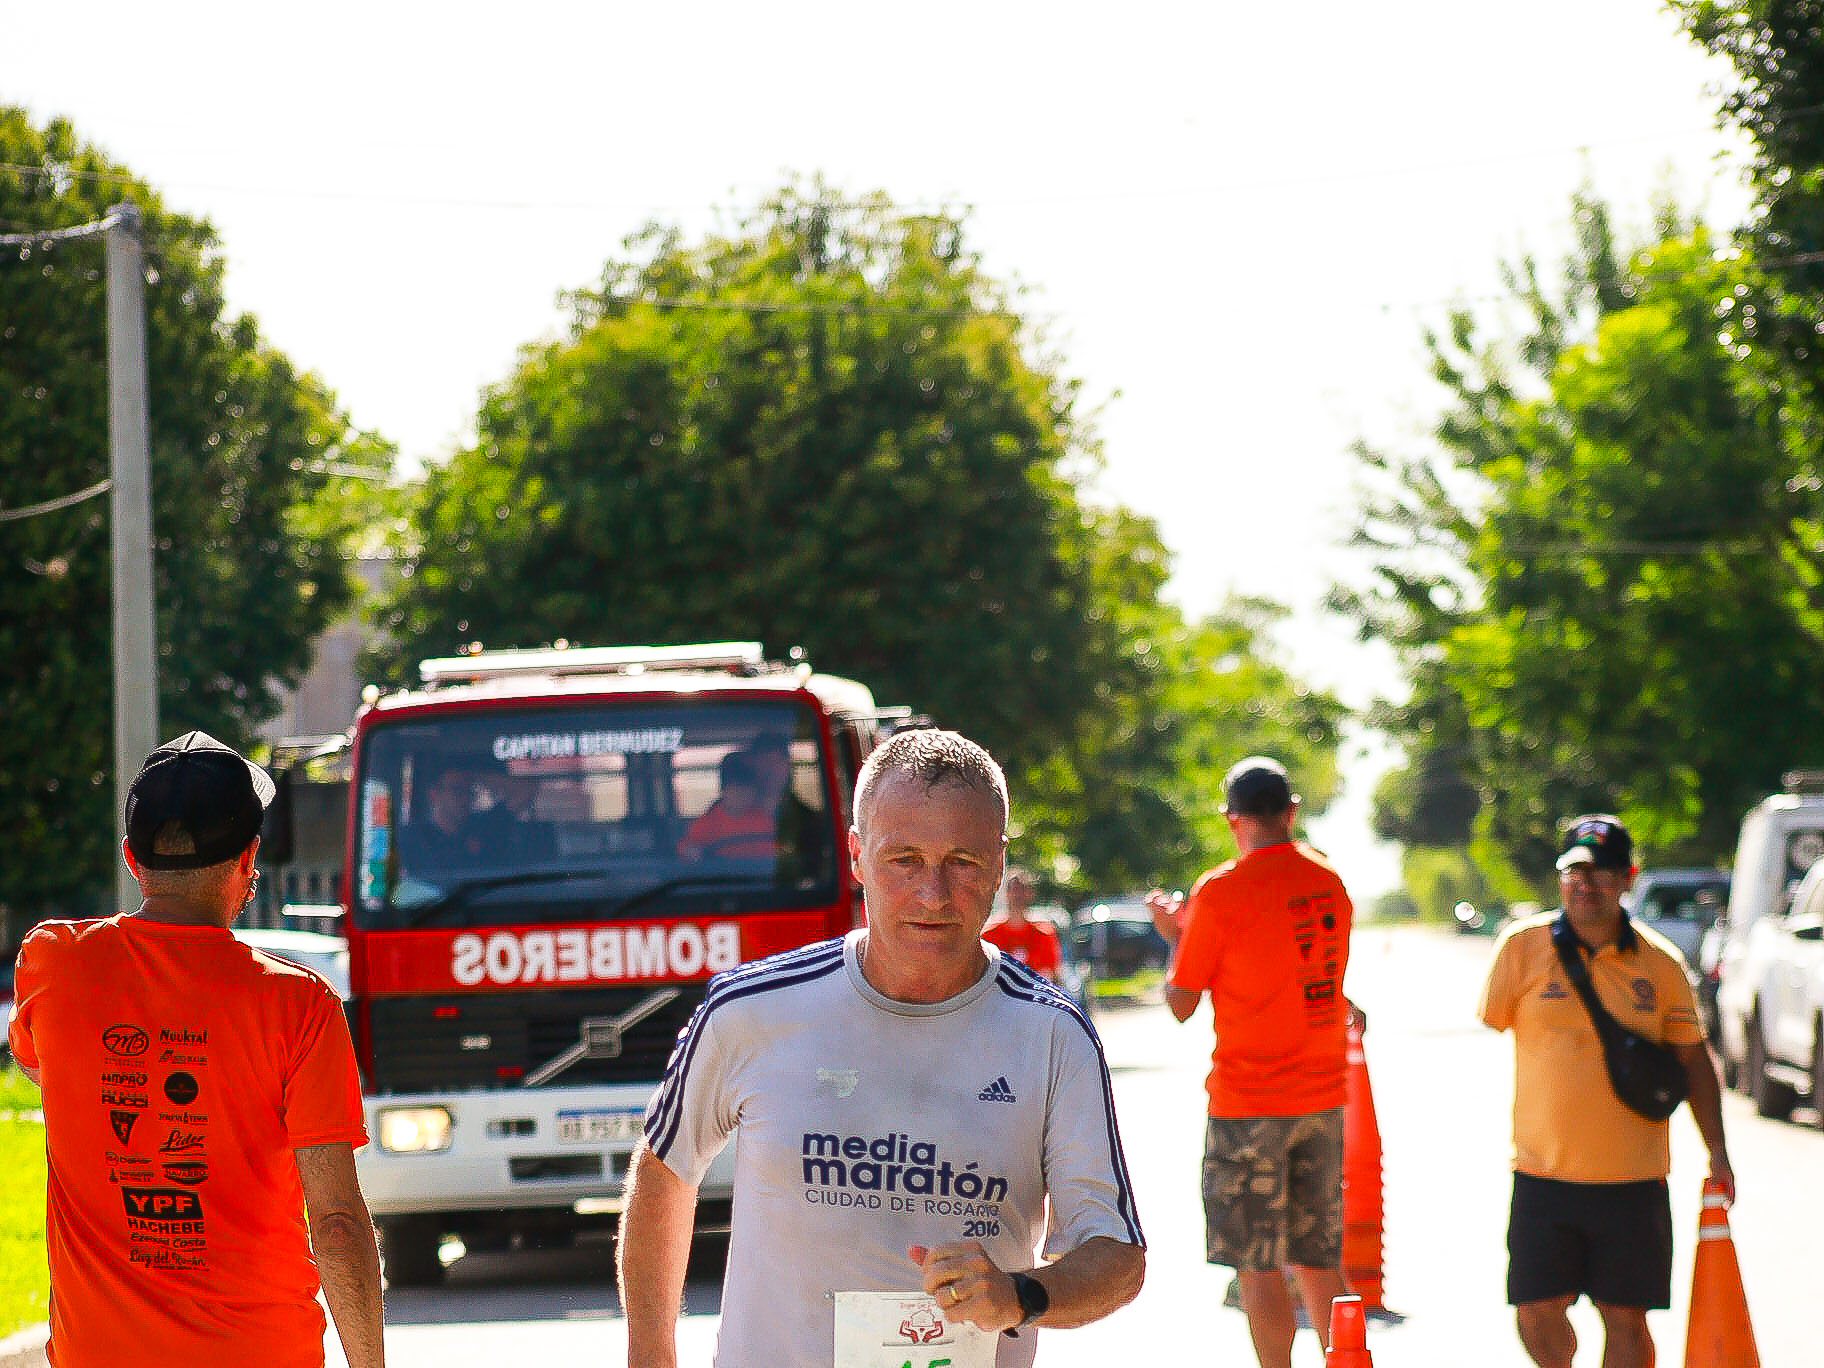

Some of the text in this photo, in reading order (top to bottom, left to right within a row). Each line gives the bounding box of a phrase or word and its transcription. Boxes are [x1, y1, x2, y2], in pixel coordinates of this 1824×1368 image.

[493, 725, 685, 761] CAPITAN BERMUDEZ
[978, 1092, 1017, 1104] adidas
[803, 1132, 937, 1166] media
[802, 1157, 1009, 1203] maratón
[129, 1193, 193, 1214] YPF
[805, 1189, 882, 1210] CIUDAD
[890, 1196, 915, 1213] DE
[127, 1217, 205, 1235] HACHEBE
[962, 1220, 1000, 1238] 2016
